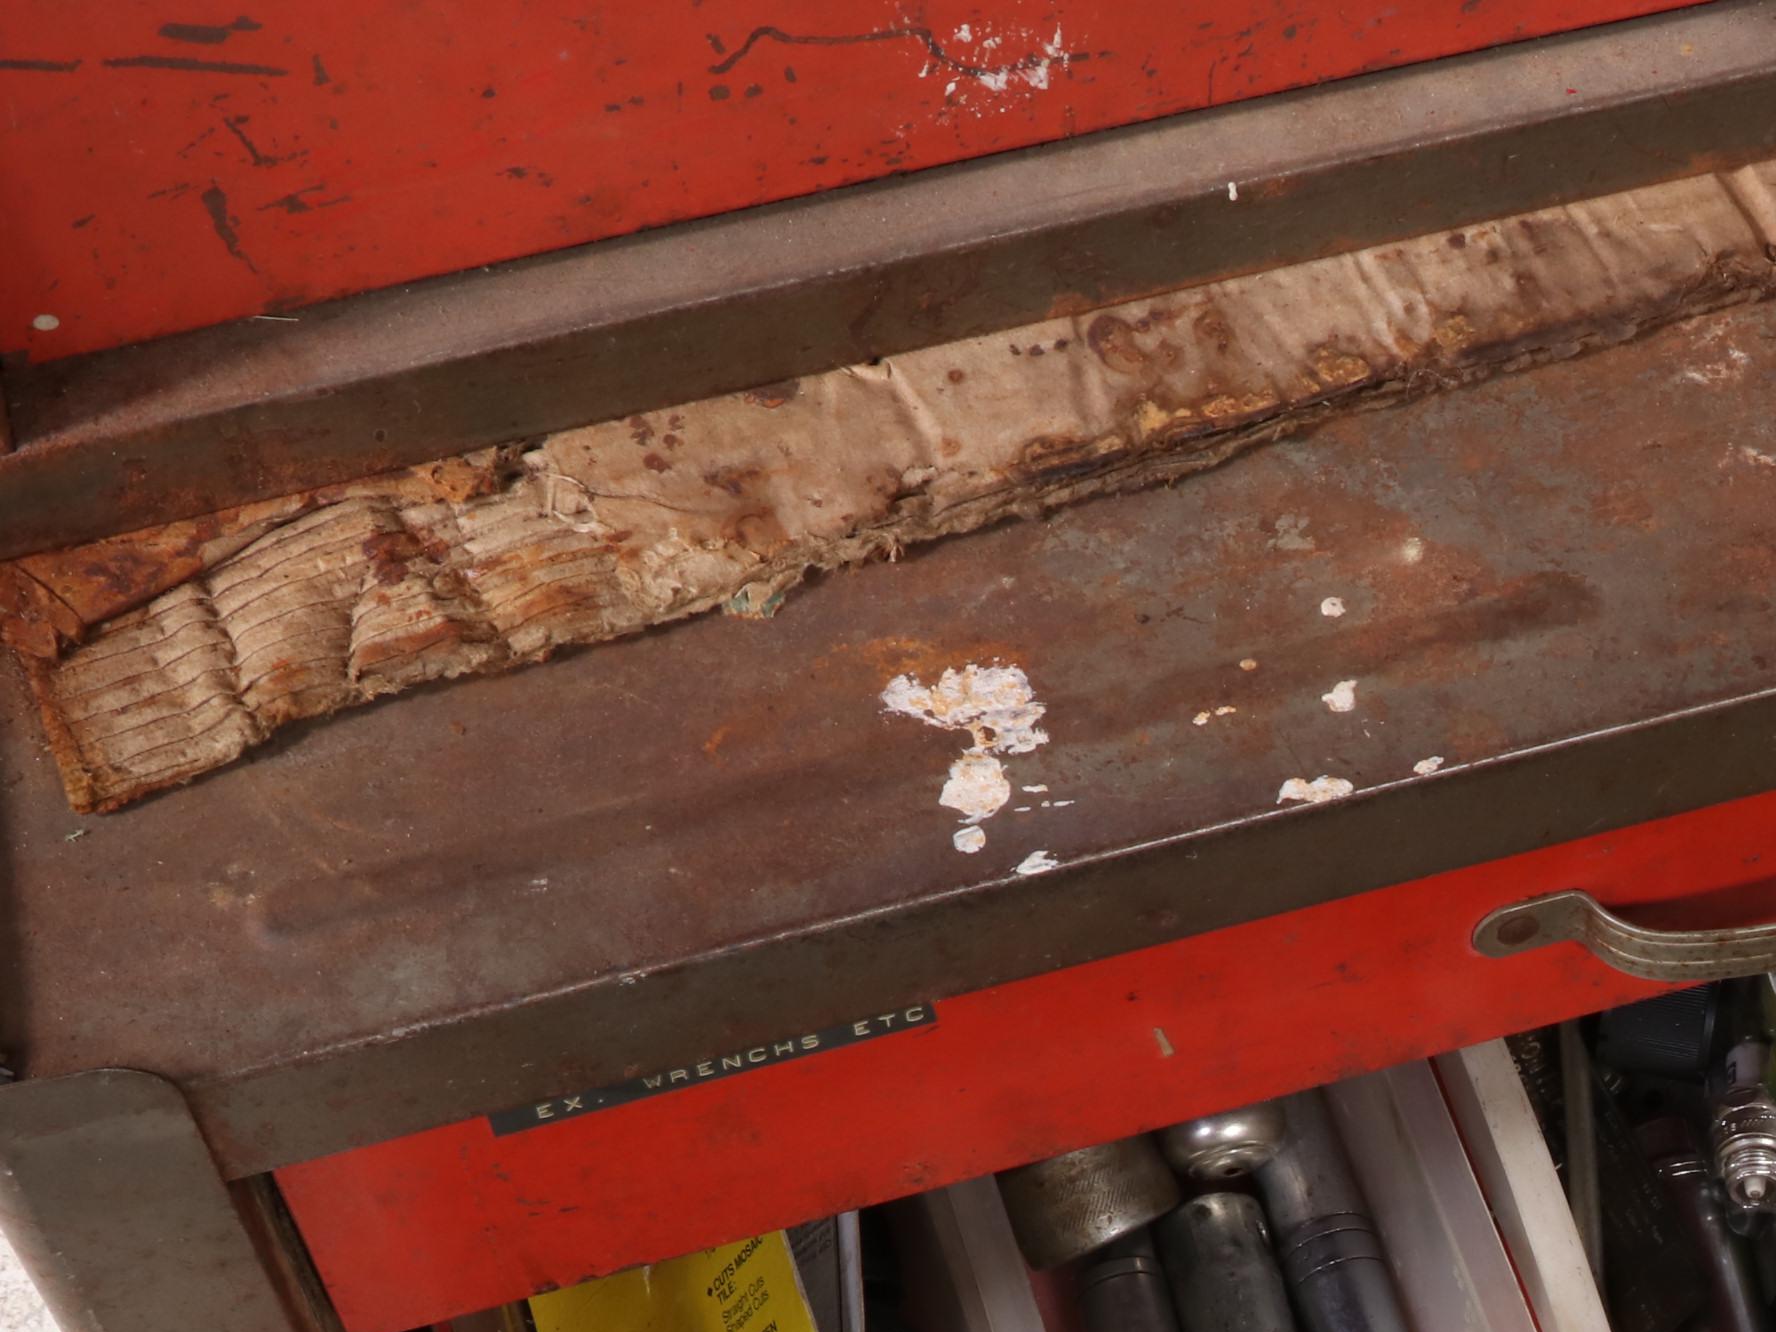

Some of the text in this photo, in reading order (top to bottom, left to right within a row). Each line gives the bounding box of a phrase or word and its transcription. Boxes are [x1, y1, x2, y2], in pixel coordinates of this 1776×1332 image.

[643, 1034, 820, 1090] WRENCHS
[853, 1005, 925, 1037] ETC
[713, 1263, 735, 1292] CUTS
